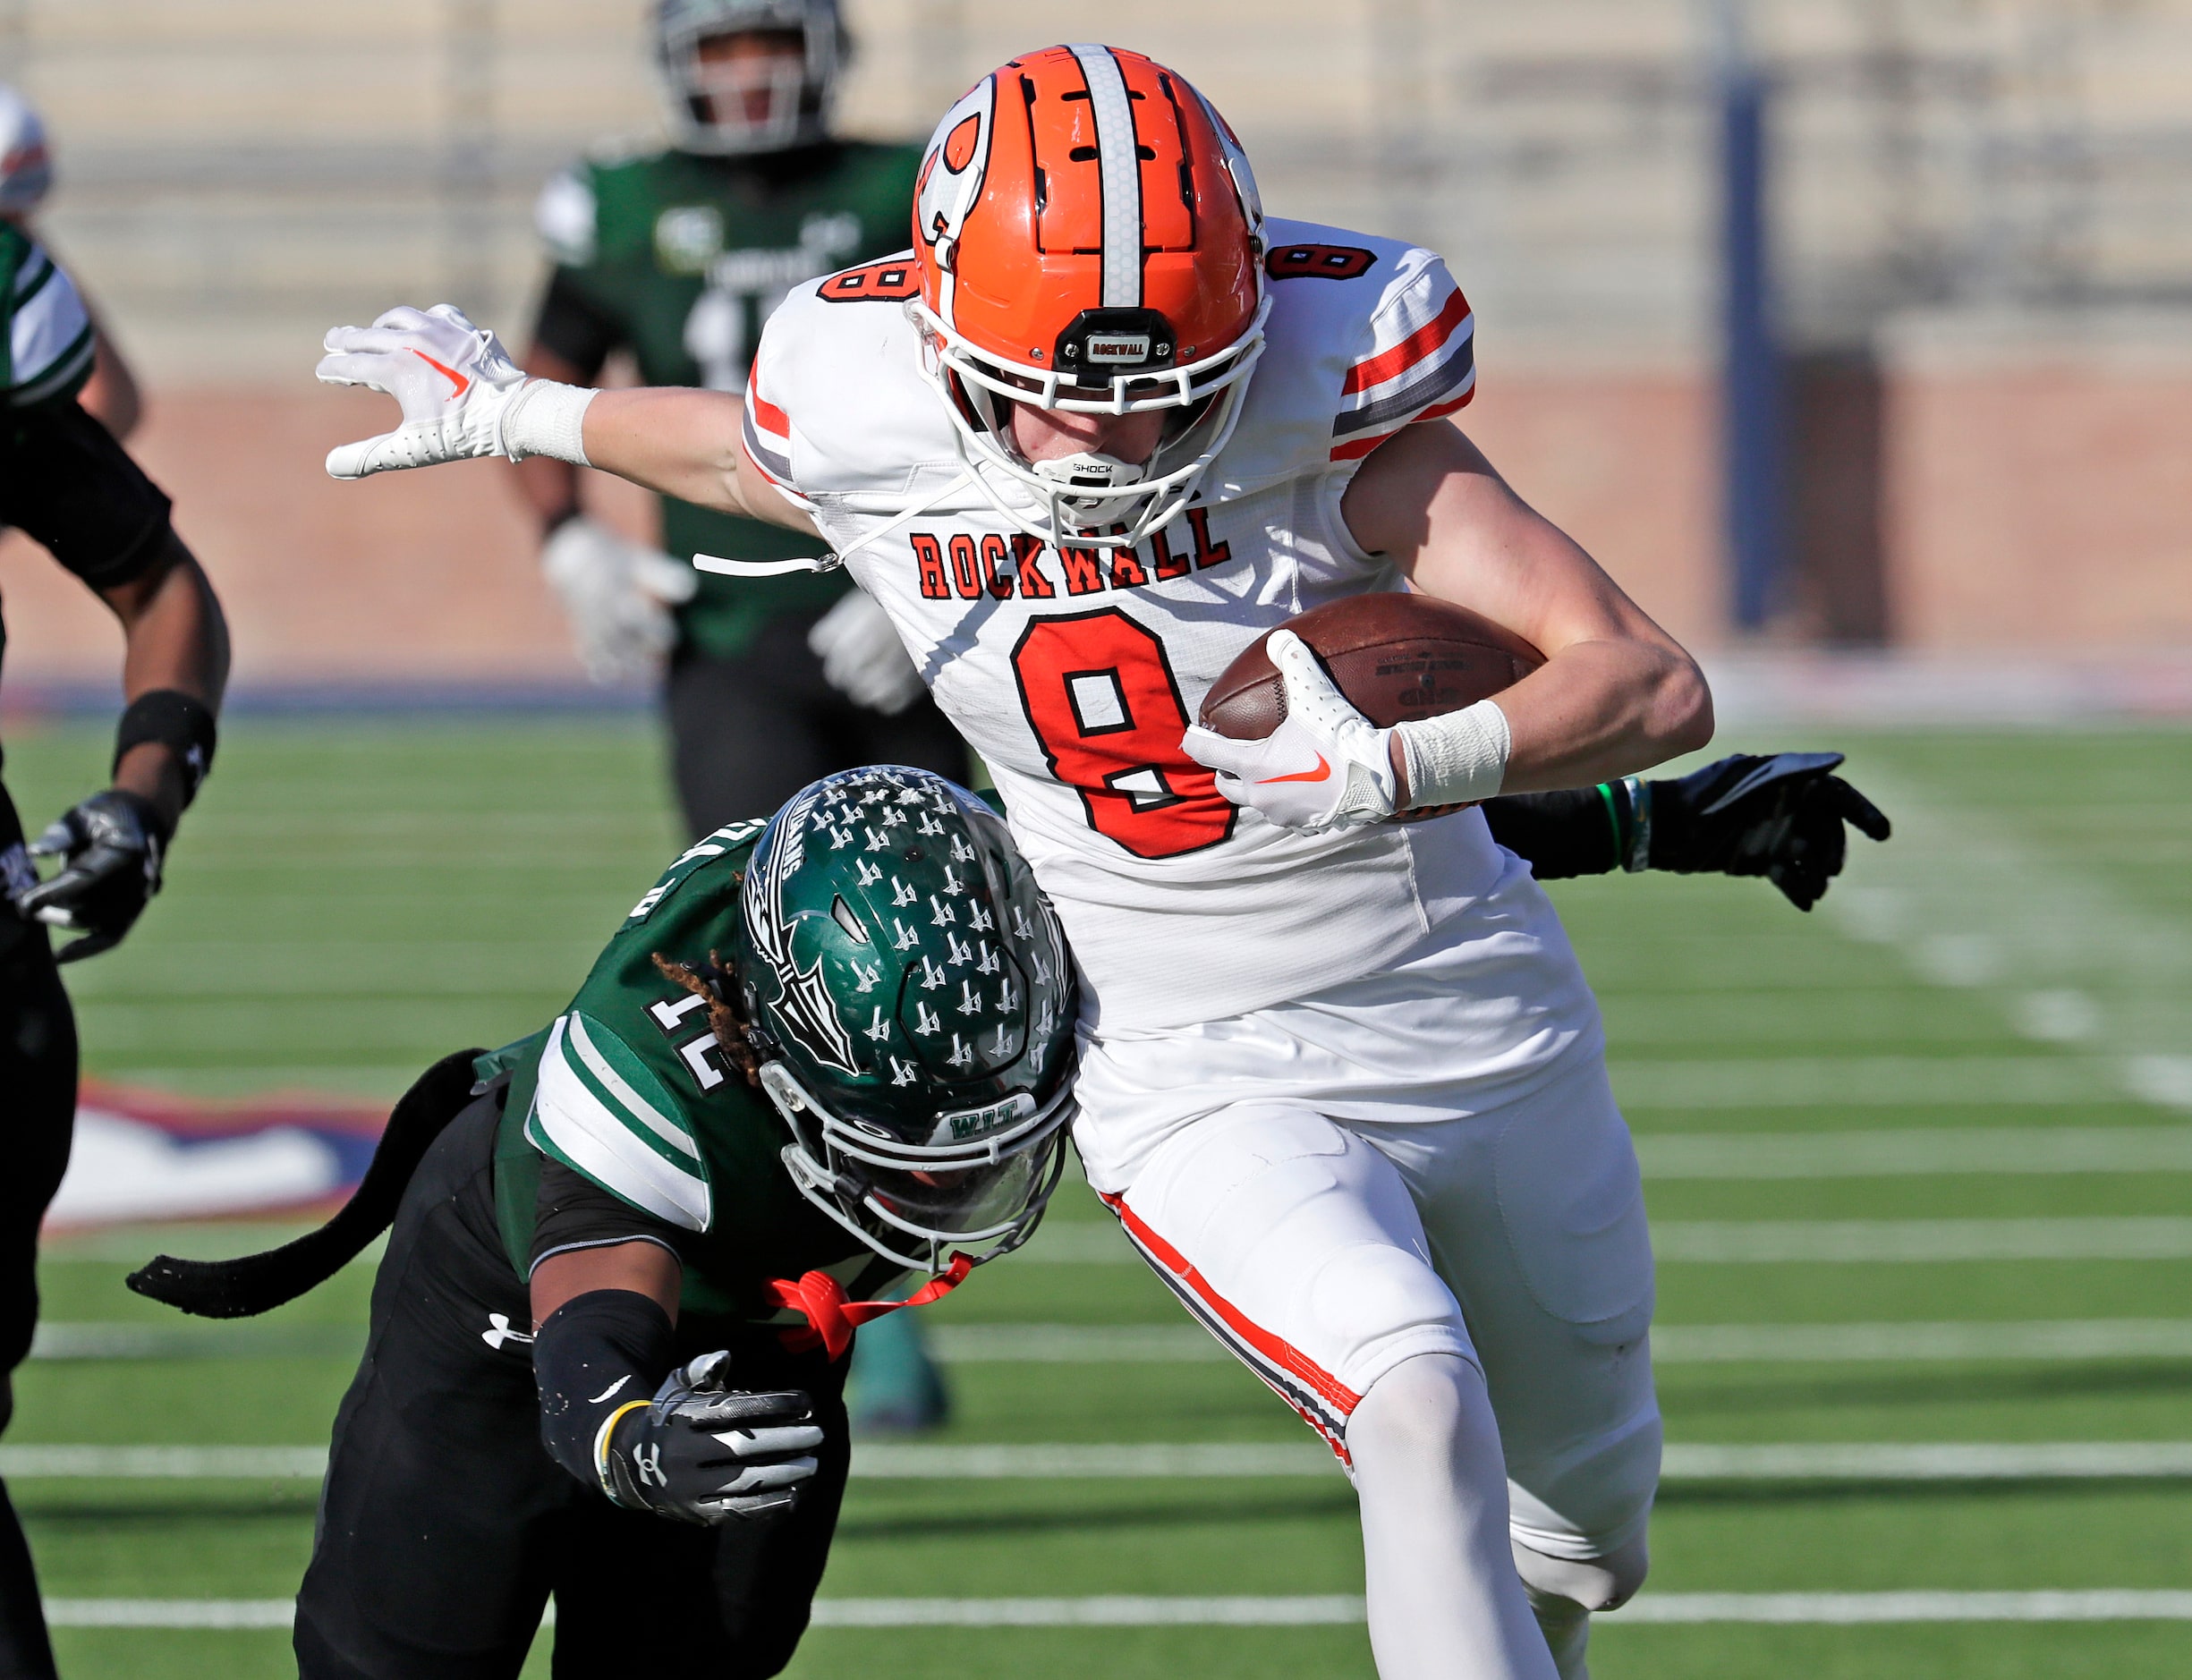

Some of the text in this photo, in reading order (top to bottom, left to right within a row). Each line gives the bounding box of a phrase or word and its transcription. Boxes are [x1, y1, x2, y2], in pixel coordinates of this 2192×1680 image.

[816, 258, 920, 302] 8
[1265, 243, 1378, 281] 8
[1092, 344, 1143, 355] ROCKWALL
[1073, 463, 1113, 473] SHOCK
[910, 507, 1231, 600] ROCKWALL
[1010, 606, 1238, 859] 8
